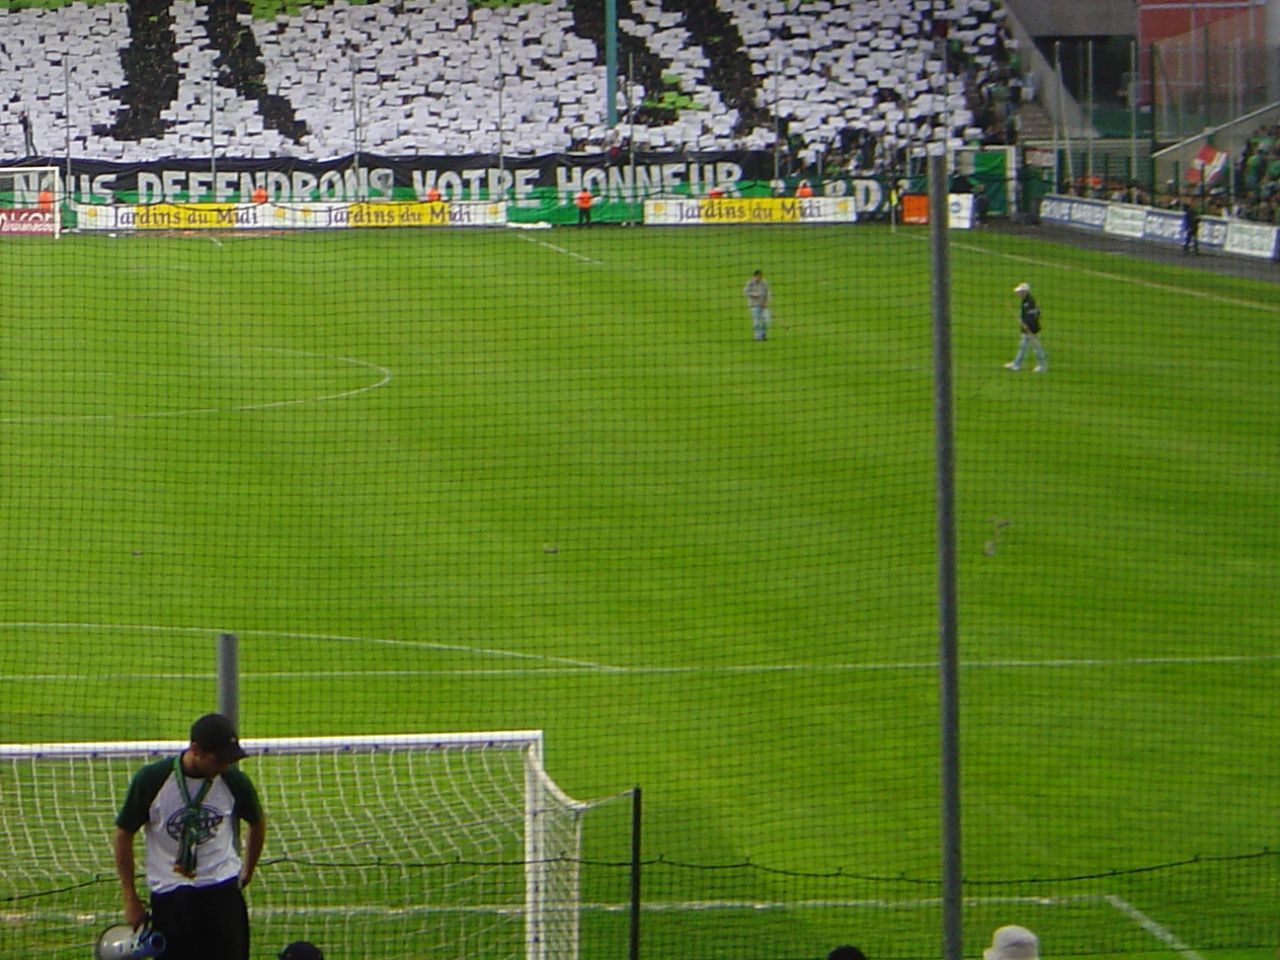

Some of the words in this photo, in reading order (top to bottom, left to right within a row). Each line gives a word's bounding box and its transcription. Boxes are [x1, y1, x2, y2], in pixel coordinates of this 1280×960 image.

[412, 168, 540, 207] VOTRE
[557, 162, 742, 205] HONNEUR
[114, 206, 181, 227] Jardins
[187, 208, 209, 224] du
[216, 206, 259, 224] Midi
[326, 205, 395, 226] Jardins
[401, 208, 422, 221] du
[430, 205, 471, 222] Midi
[677, 201, 746, 222] Jardins
[752, 202, 773, 218] du
[781, 200, 822, 218] Midi
